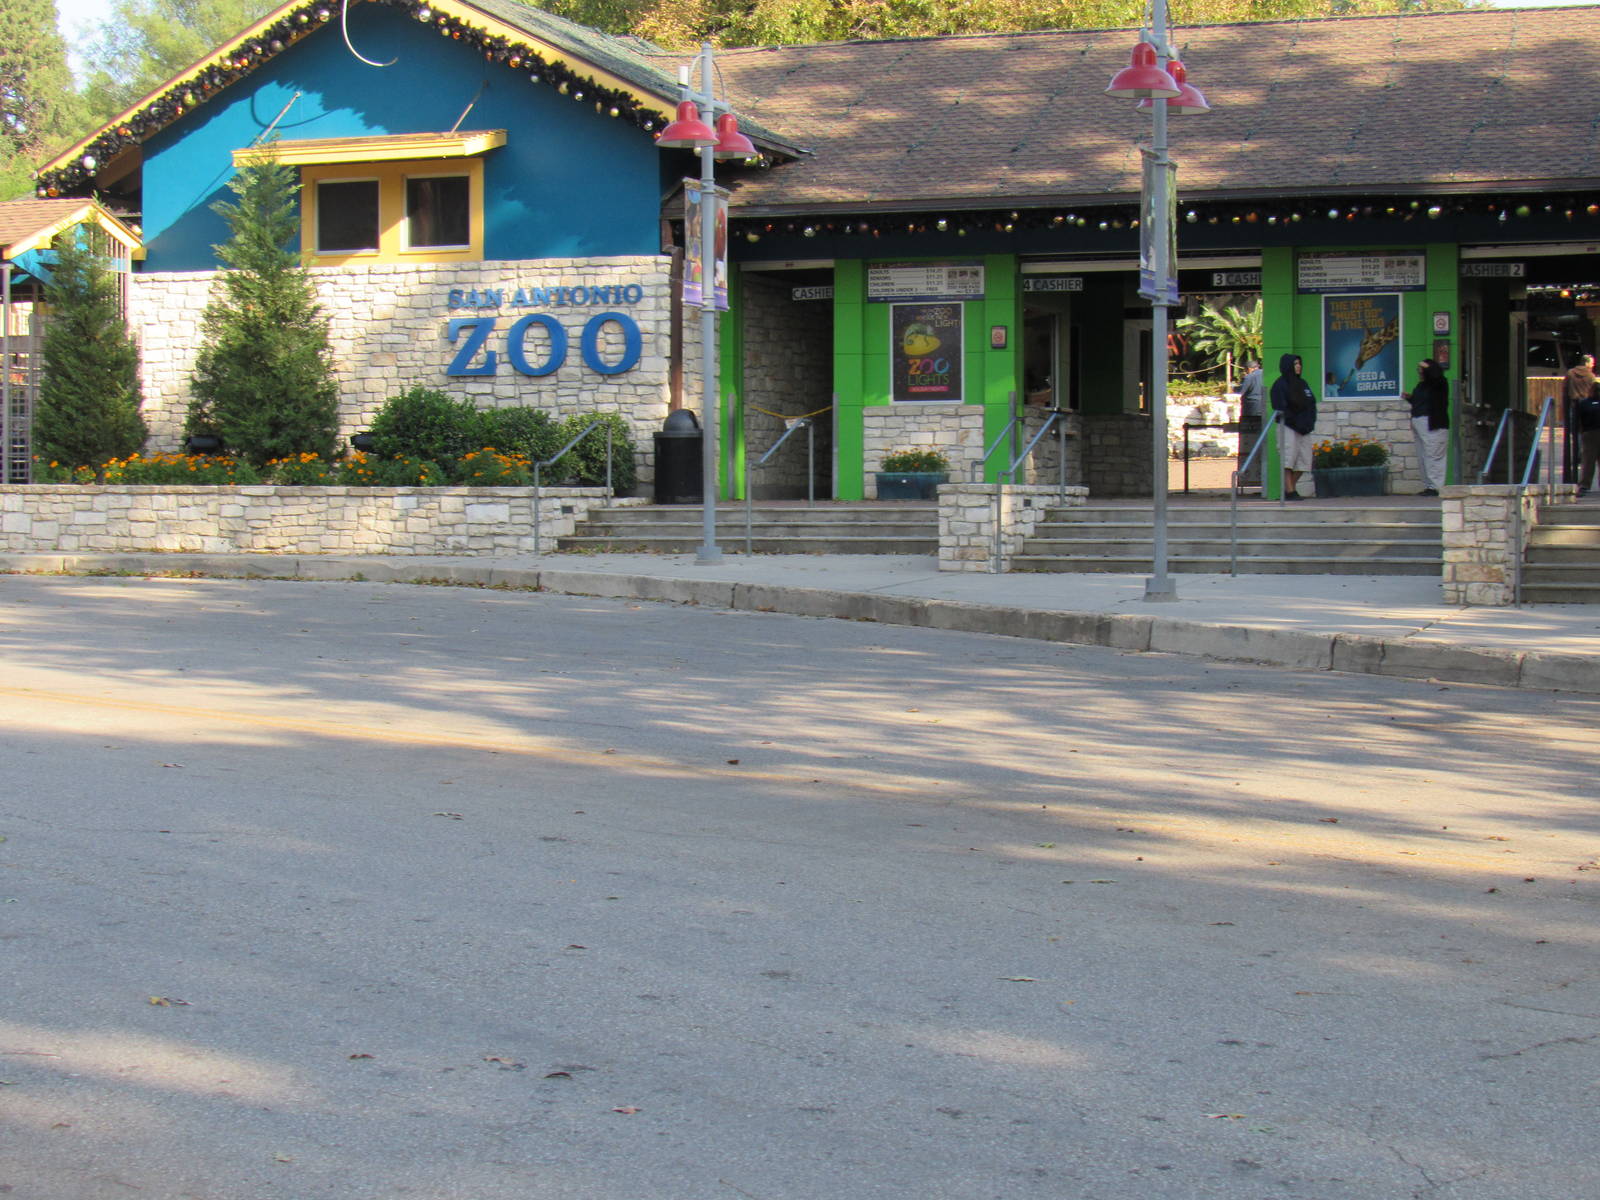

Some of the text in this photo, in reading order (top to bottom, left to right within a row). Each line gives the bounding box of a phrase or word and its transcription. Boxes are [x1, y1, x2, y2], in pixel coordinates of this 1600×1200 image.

[1513, 264, 1521, 275] 2
[1023, 279, 1083, 290] 4 CASHIER
[1216, 273, 1224, 285] 3
[448, 284, 643, 309] SAN ANTONIO
[793, 287, 833, 299] CASHIE
[447, 311, 642, 375] ZOO
[908, 359, 951, 375] ZOO
[907, 374, 950, 385] LIGHTS
[1357, 371, 1386, 381] FEED A
[1356, 380, 1395, 392] GIRAFFE!
